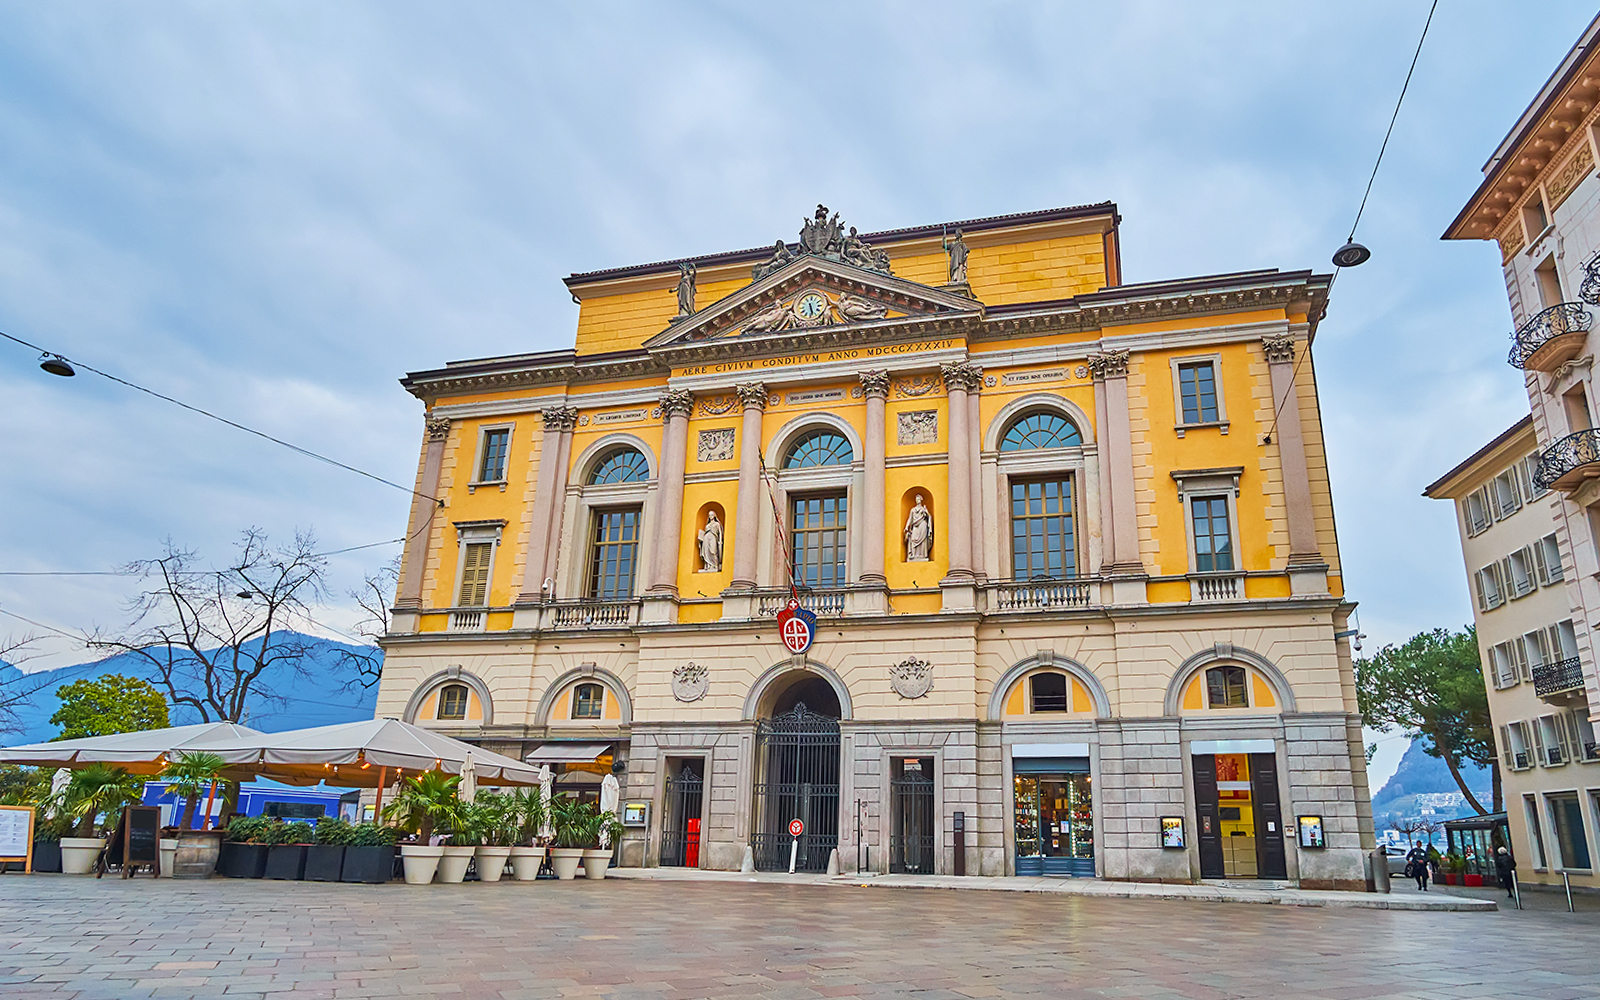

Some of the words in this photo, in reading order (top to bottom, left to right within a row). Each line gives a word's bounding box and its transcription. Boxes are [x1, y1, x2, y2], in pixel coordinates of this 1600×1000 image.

[682, 366, 708, 376] AERE
[715, 361, 754, 372] CIVIVM
[762, 355, 819, 367] CONDITVM
[828, 350, 859, 360] ANNO
[867, 340, 953, 356] MDCCCXXXXIV
